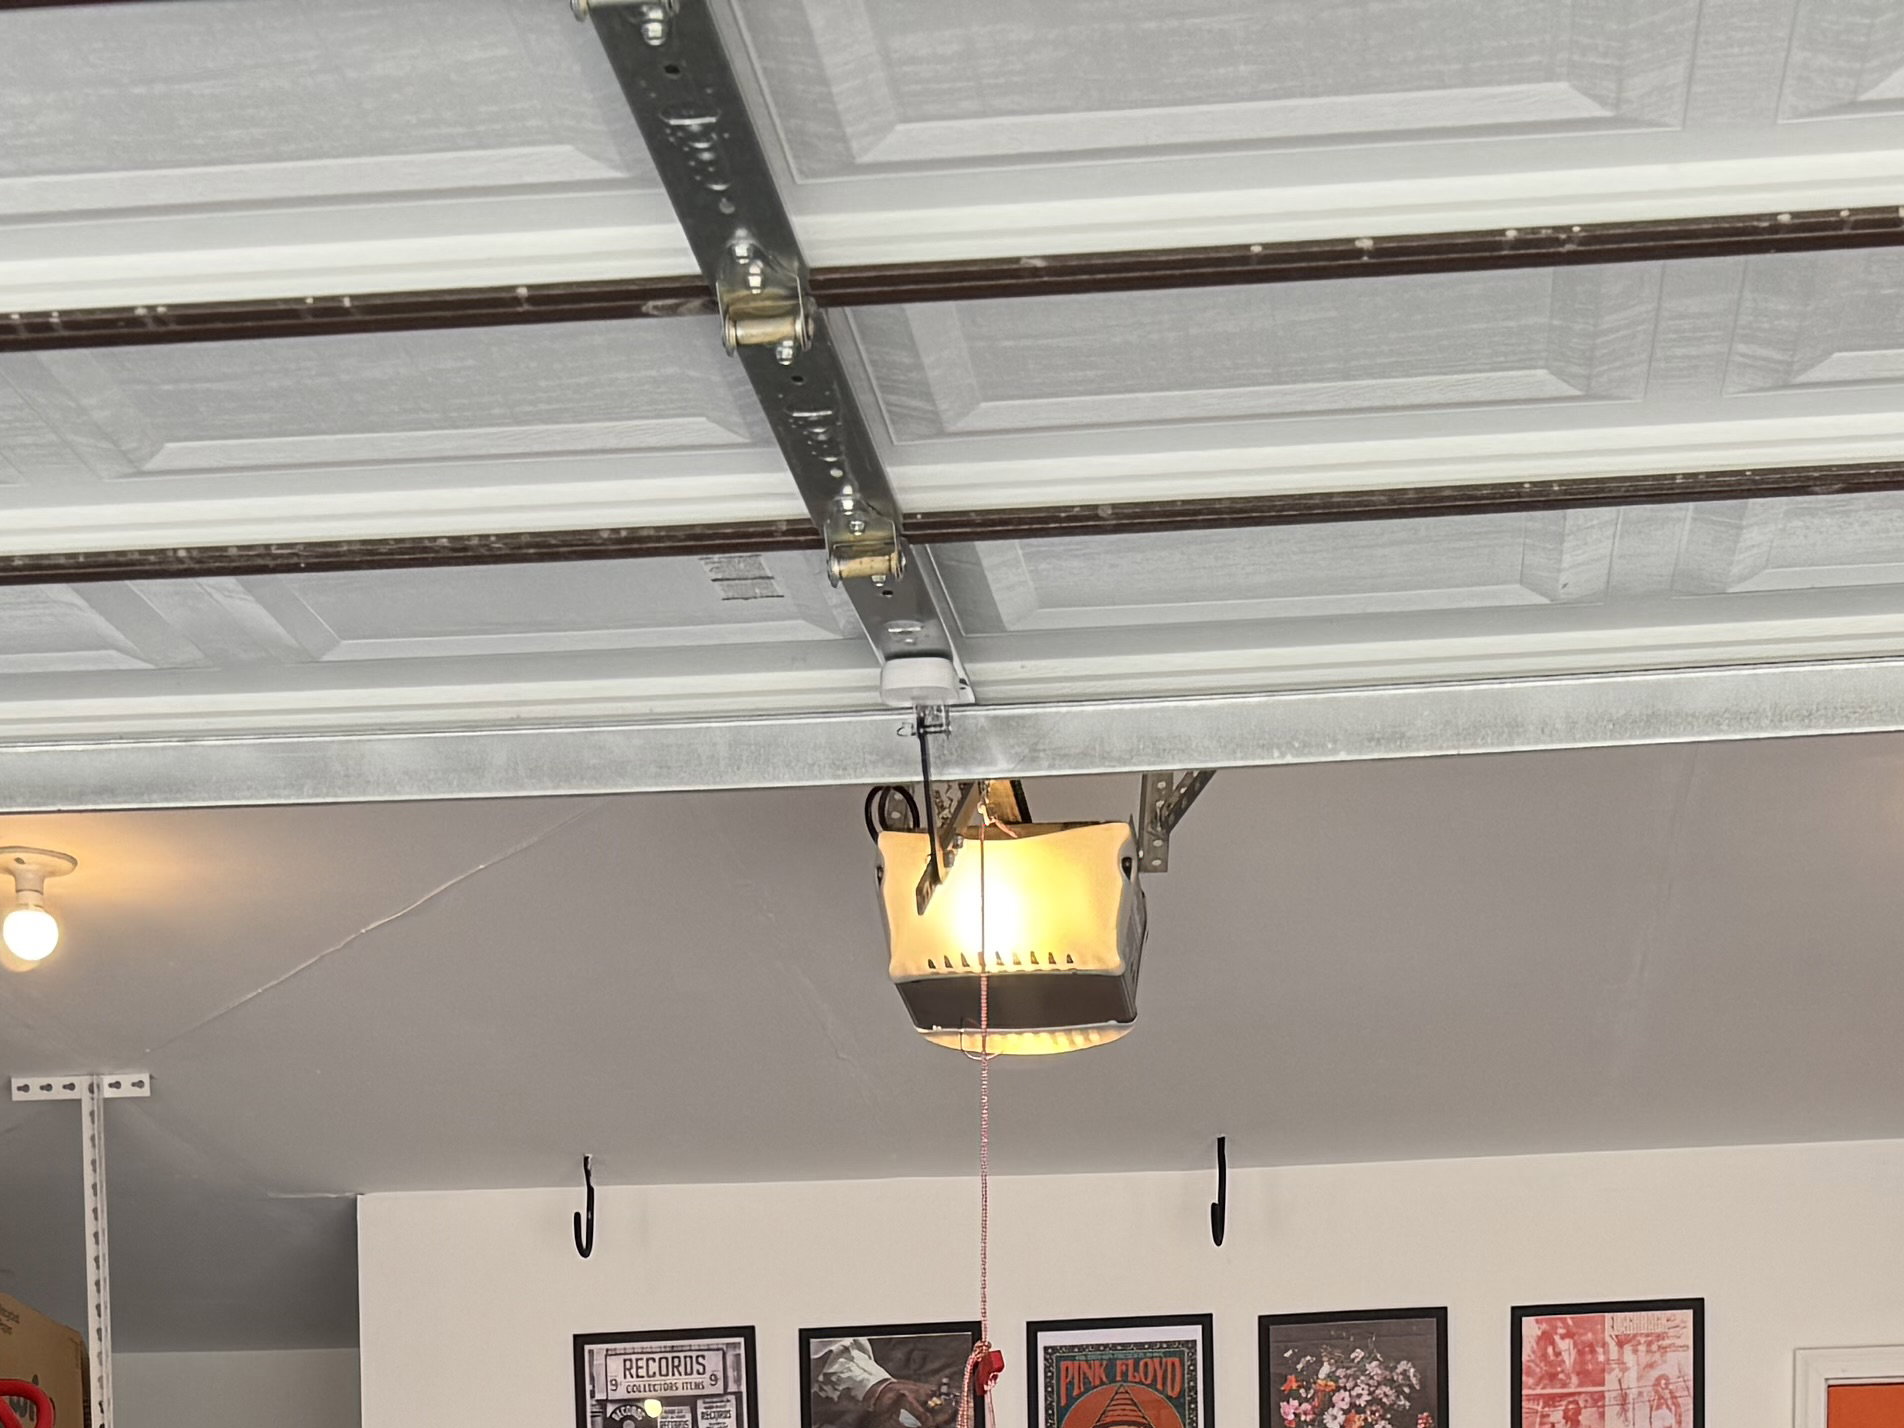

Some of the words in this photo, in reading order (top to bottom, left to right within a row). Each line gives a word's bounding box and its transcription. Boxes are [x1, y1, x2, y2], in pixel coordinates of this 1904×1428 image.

[623, 1354, 706, 1379] RECORDS
[626, 1381, 678, 1394] COLLECTORS
[682, 1380, 705, 1391] ITEMS
[1060, 1358, 1109, 1407] PINK
[1117, 1357, 1183, 1398] FLOYD
[701, 1410, 732, 1421] RECORDS
